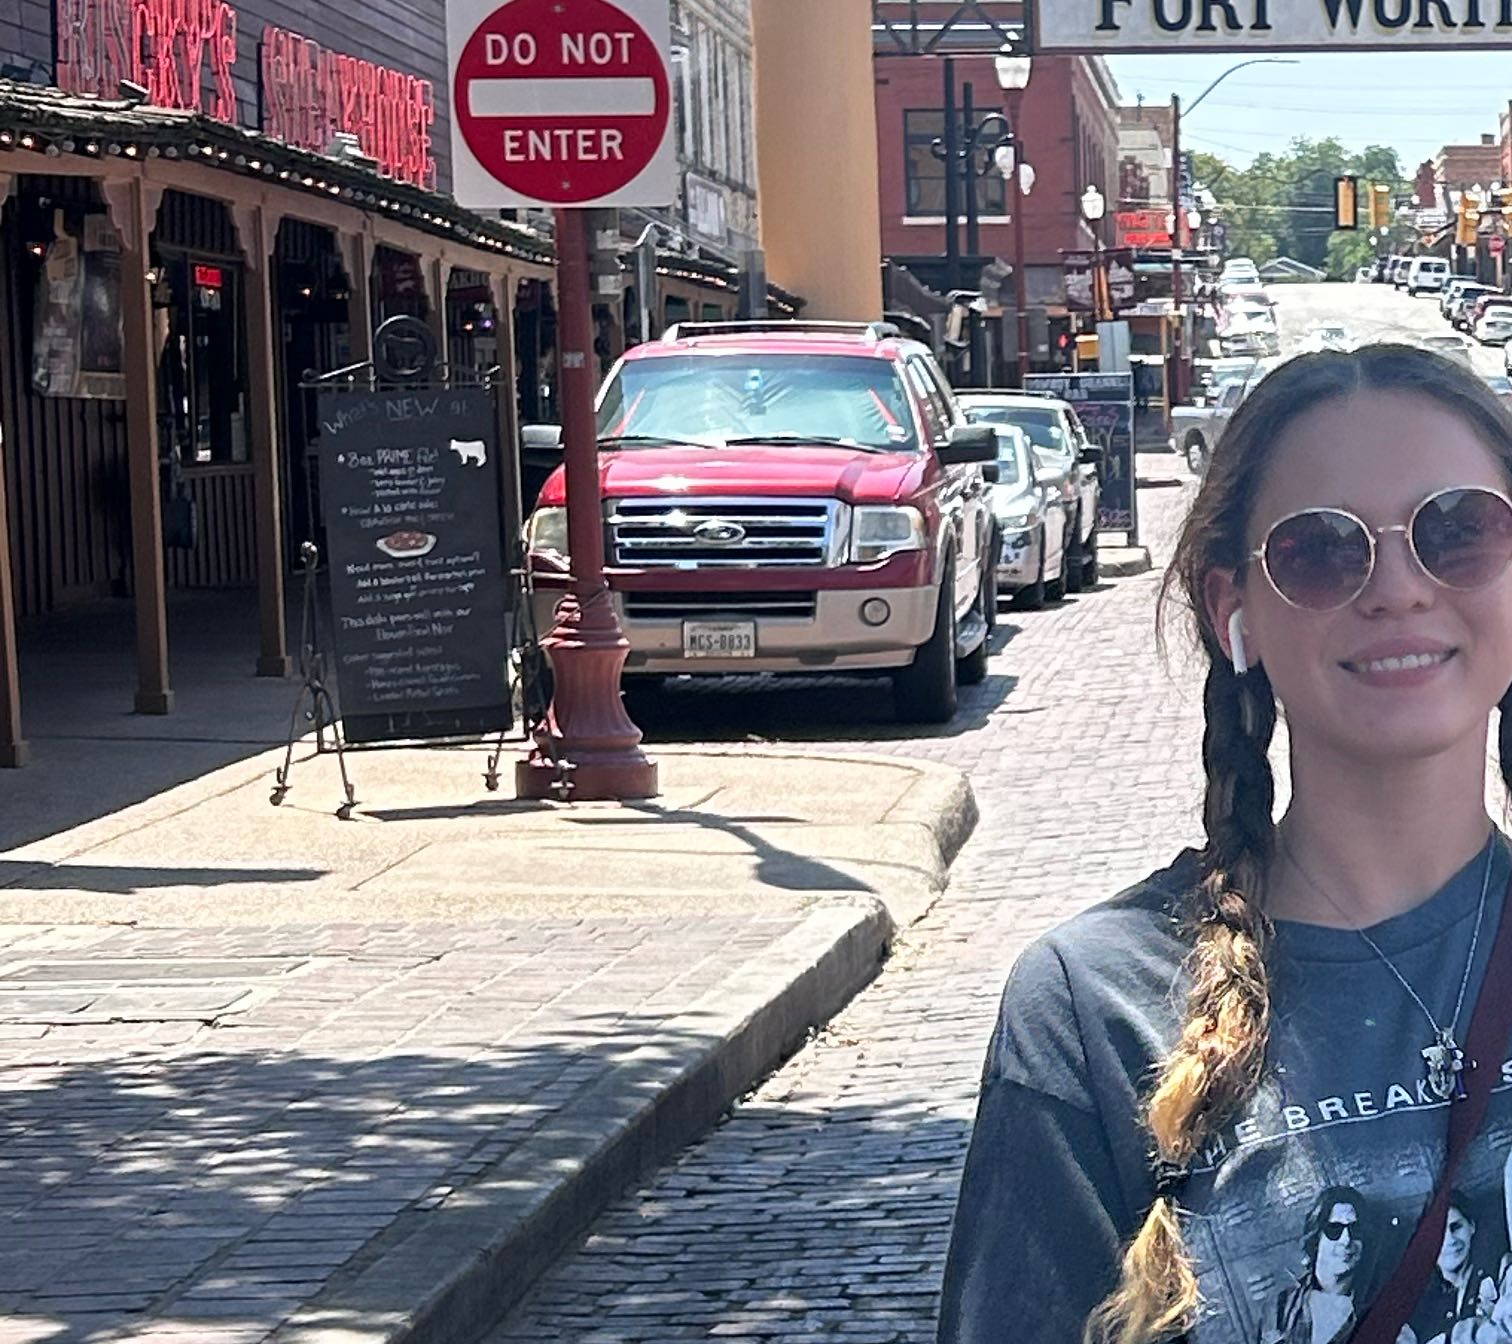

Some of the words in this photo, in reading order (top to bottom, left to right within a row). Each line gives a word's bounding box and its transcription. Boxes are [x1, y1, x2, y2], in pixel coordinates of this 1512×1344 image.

[485, 32, 537, 66] DO
[561, 31, 635, 65] NOT
[503, 128, 624, 161] ENTER
[386, 398, 439, 418] NEW
[376, 448, 414, 464] PRIME
